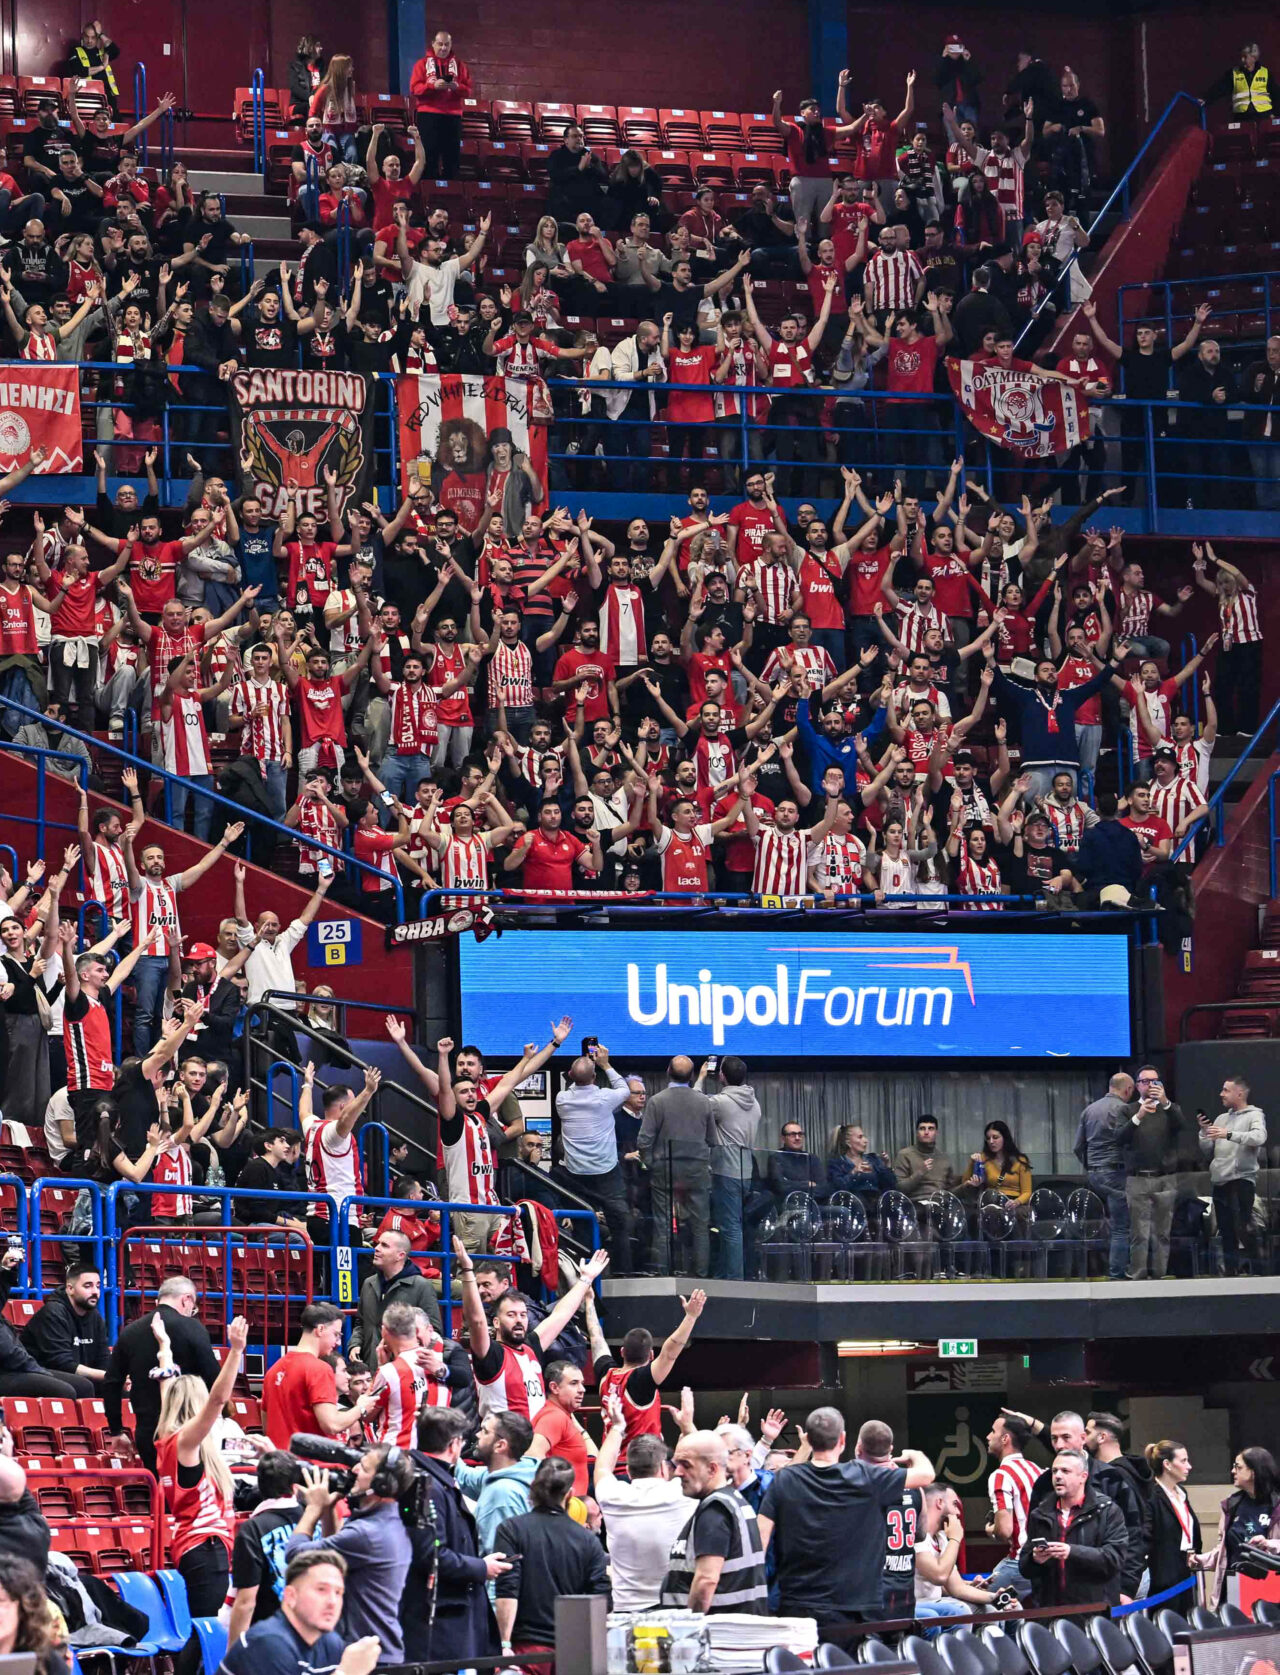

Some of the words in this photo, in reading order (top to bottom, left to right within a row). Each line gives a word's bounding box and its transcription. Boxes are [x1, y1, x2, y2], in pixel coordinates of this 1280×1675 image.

[234, 370, 365, 408] SANTORINI
[404, 400, 430, 432] RED
[426, 382, 478, 408] WHITE
[809, 582, 833, 593] bwi
[7, 608, 20, 618] 94
[621, 603, 629, 615] 7
[38, 617, 45, 628] 7
[1075, 667, 1092, 678] 94
[692, 845, 702, 856] 12
[454, 875, 484, 889] bwin
[157, 894, 166, 907] 15
[768, 899, 777, 908] B
[323, 924, 346, 940] 25
[331, 949, 340, 959] B
[627, 963, 953, 1046] UnipolForum
[472, 1159, 494, 1176] bwi
[338, 1252, 350, 1268] 24
[341, 1285, 348, 1300] B
[887, 1507, 917, 1550] 33
